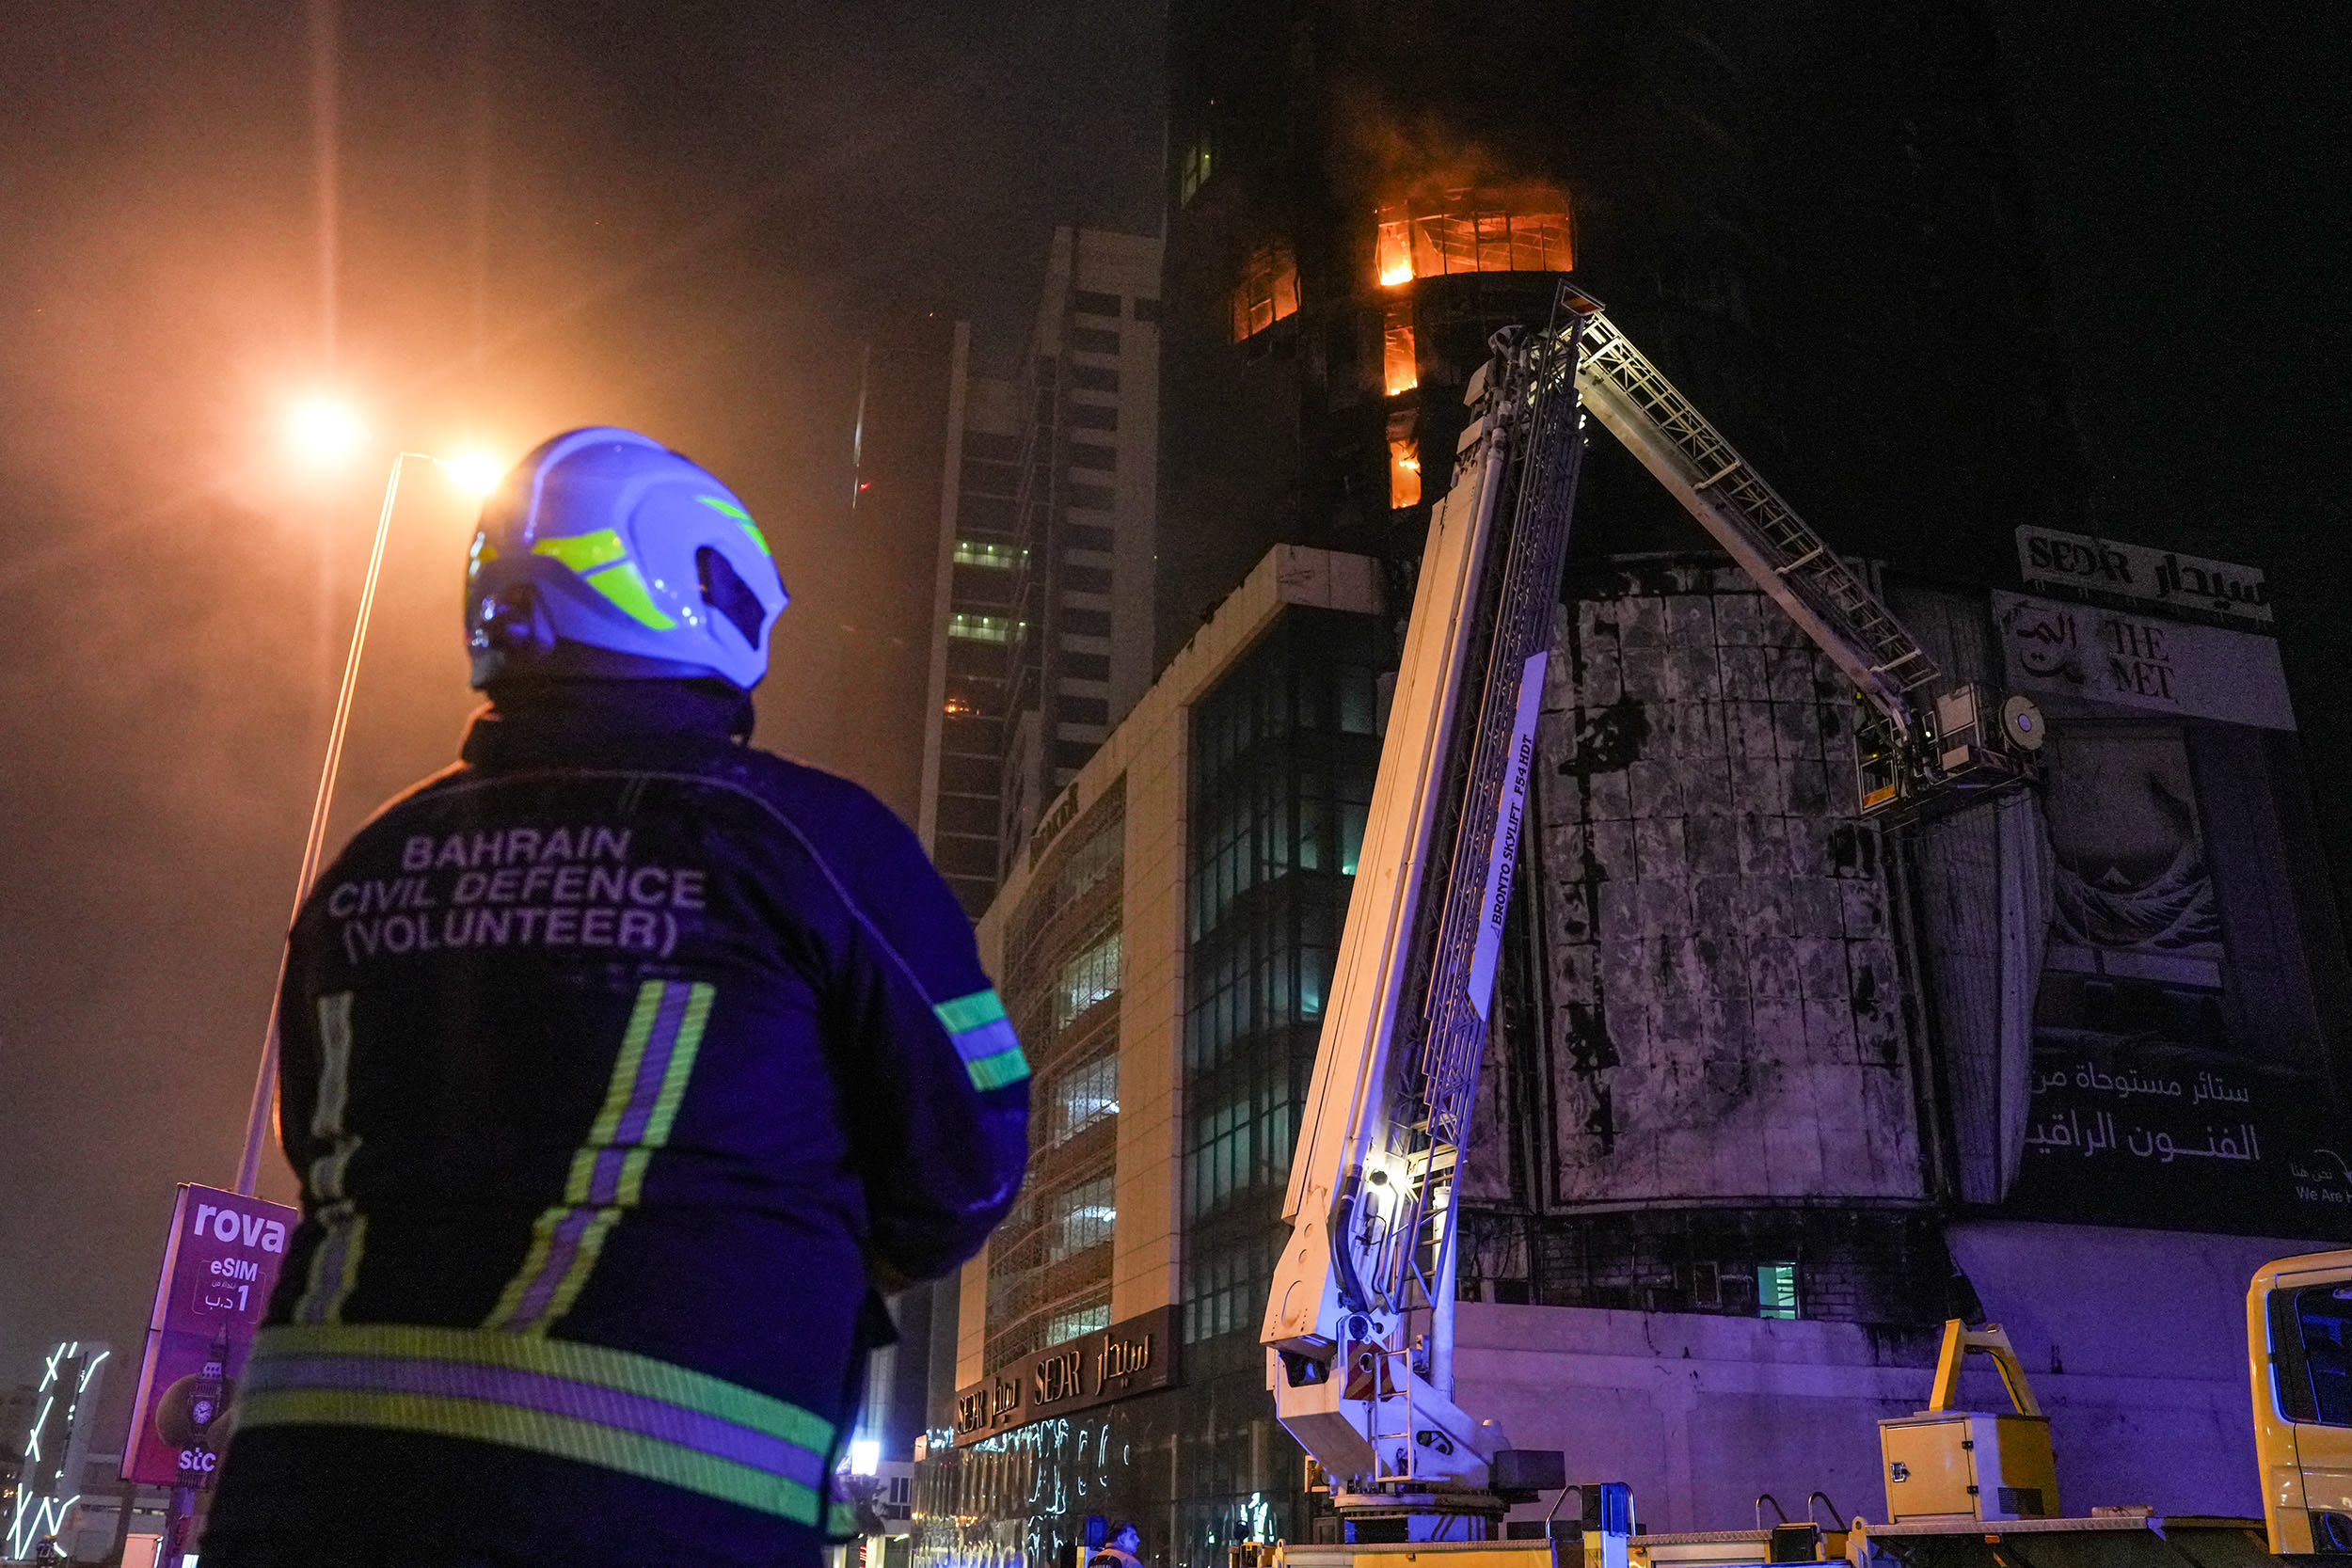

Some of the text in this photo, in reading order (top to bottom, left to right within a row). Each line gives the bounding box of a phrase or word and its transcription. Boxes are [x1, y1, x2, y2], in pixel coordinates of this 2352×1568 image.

[2106, 620, 2169, 662] THE
[2108, 658, 2176, 700] MET
[402, 826, 632, 871] BAHRAIN
[1492, 863, 1511, 927] BRONTO
[1503, 801, 1521, 862] SKYLIFT
[328, 865, 707, 918] CIVIL DEFENCE
[342, 907, 680, 965] (VOLUNTEER)
[2075, 1061, 2183, 1099] مستوحاة
[2193, 1070, 2249, 1105] ستائر
[2296, 1185, 2318, 1202] We
[2321, 1188, 2344, 1203] Are
[194, 1203, 286, 1254] rova
[210, 1257, 259, 1282] eSIM
[238, 1285, 249, 1311] 1
[179, 1447, 216, 1472] stc
